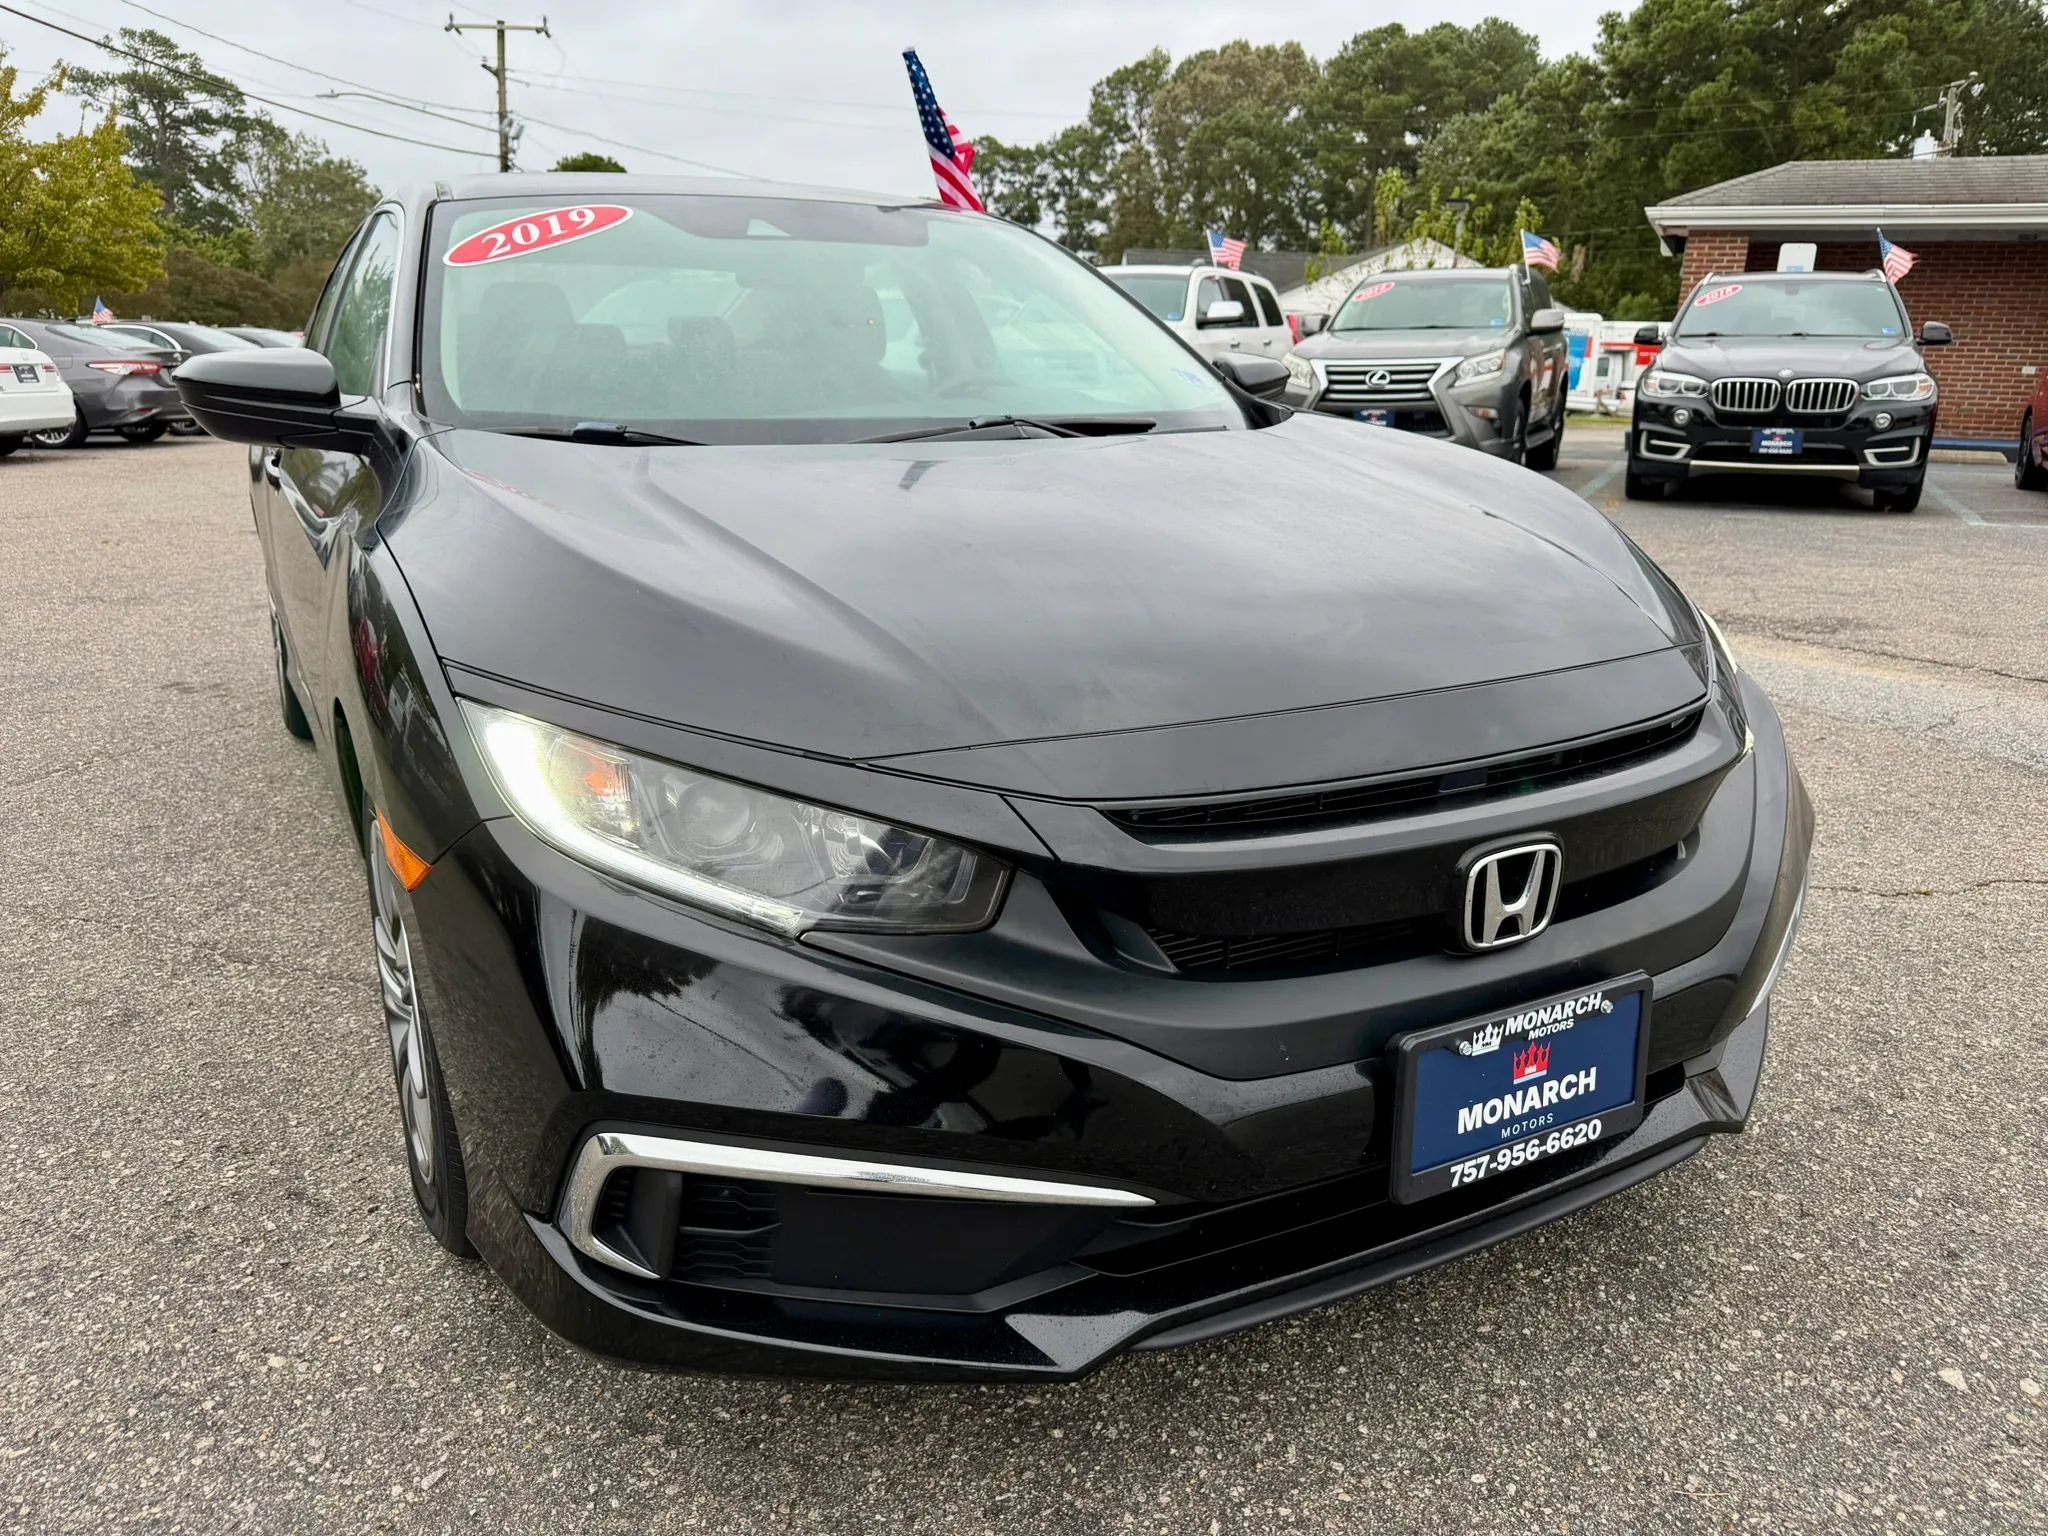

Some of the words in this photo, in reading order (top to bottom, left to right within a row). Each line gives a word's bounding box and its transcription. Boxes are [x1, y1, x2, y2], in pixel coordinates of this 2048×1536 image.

[481, 207, 596, 259] 2019
[1505, 992, 1603, 1036] MONARCH
[1528, 1018, 1575, 1041] MOTORS
[1457, 1067, 1598, 1135] MONARCH
[1501, 1113, 1554, 1139] MOTORS
[1450, 1118, 1602, 1188] 757-956-6620
